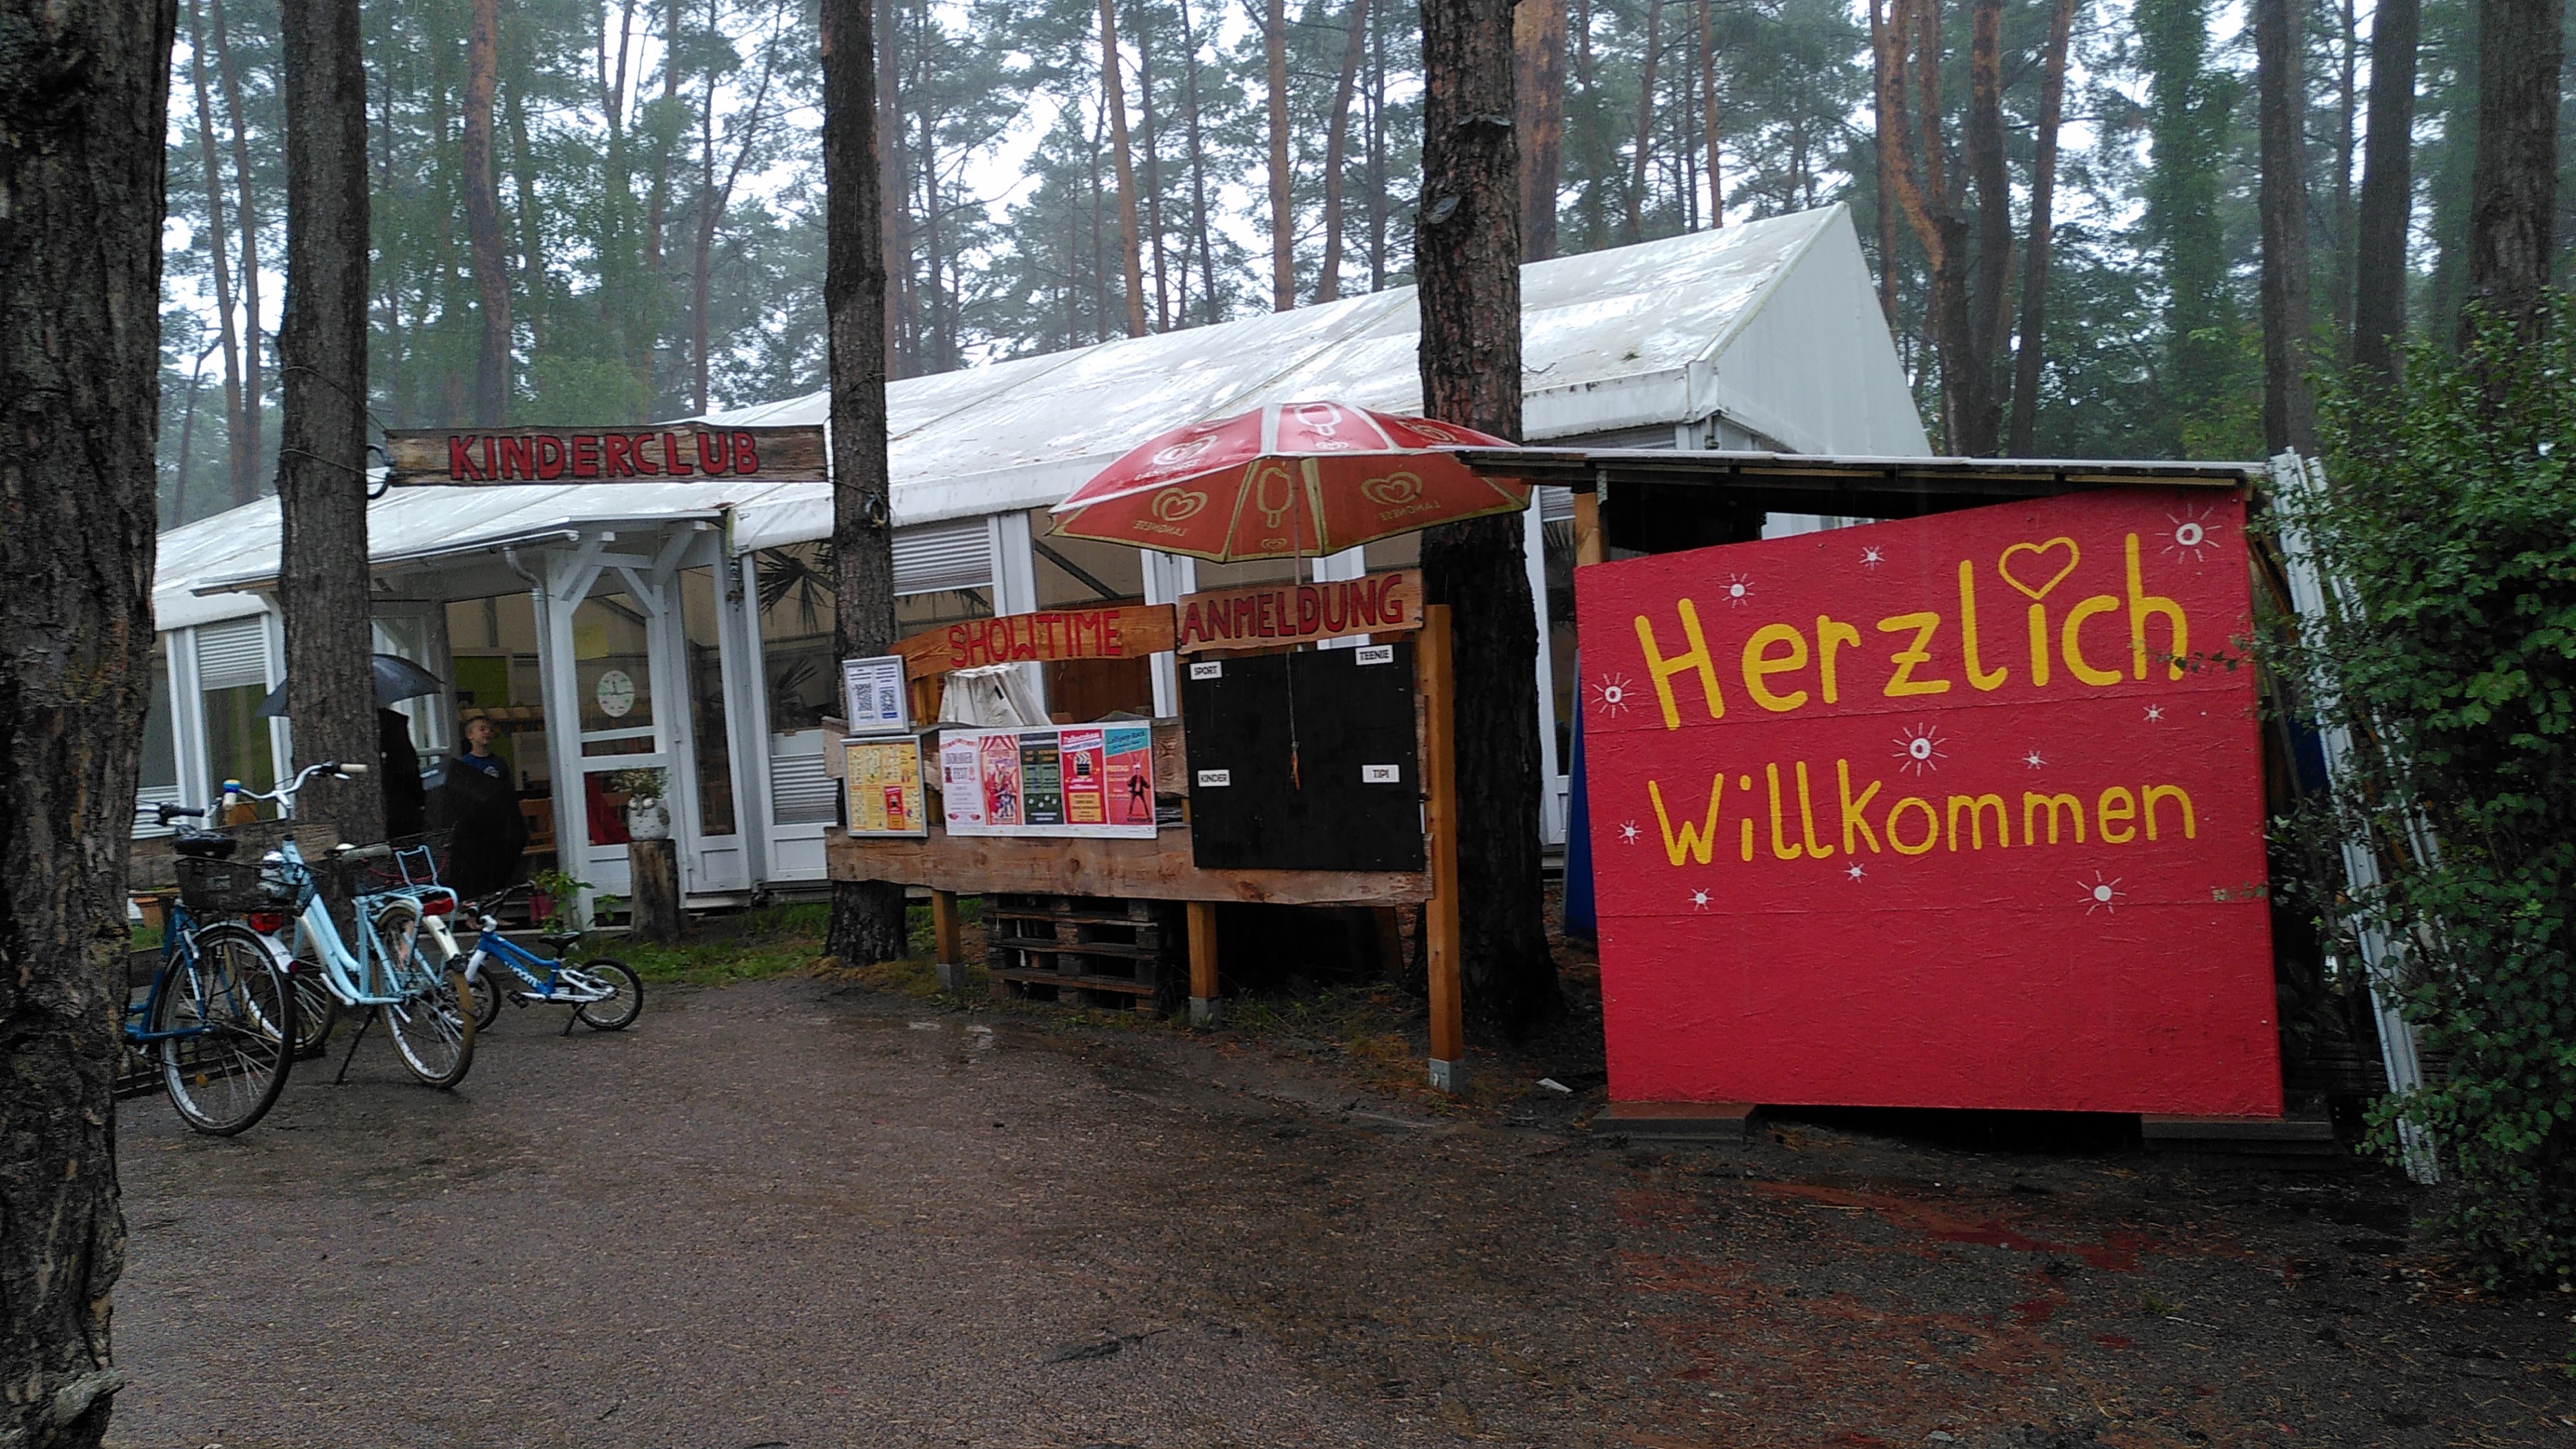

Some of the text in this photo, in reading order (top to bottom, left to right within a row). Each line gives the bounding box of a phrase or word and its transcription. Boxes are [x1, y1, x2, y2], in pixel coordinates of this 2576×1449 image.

[449, 432, 759, 481] KINDERCLUB
[1181, 573, 1404, 646] ANMELDUNG
[1634, 533, 2188, 730] Herzlich
[948, 610, 1122, 667] SHOWTIME
[1359, 649, 1389, 661] TEENIE
[1194, 665, 1218, 676] SPORT
[1371, 769, 1389, 778] TIPI
[1647, 758, 2196, 867] Willkommen
